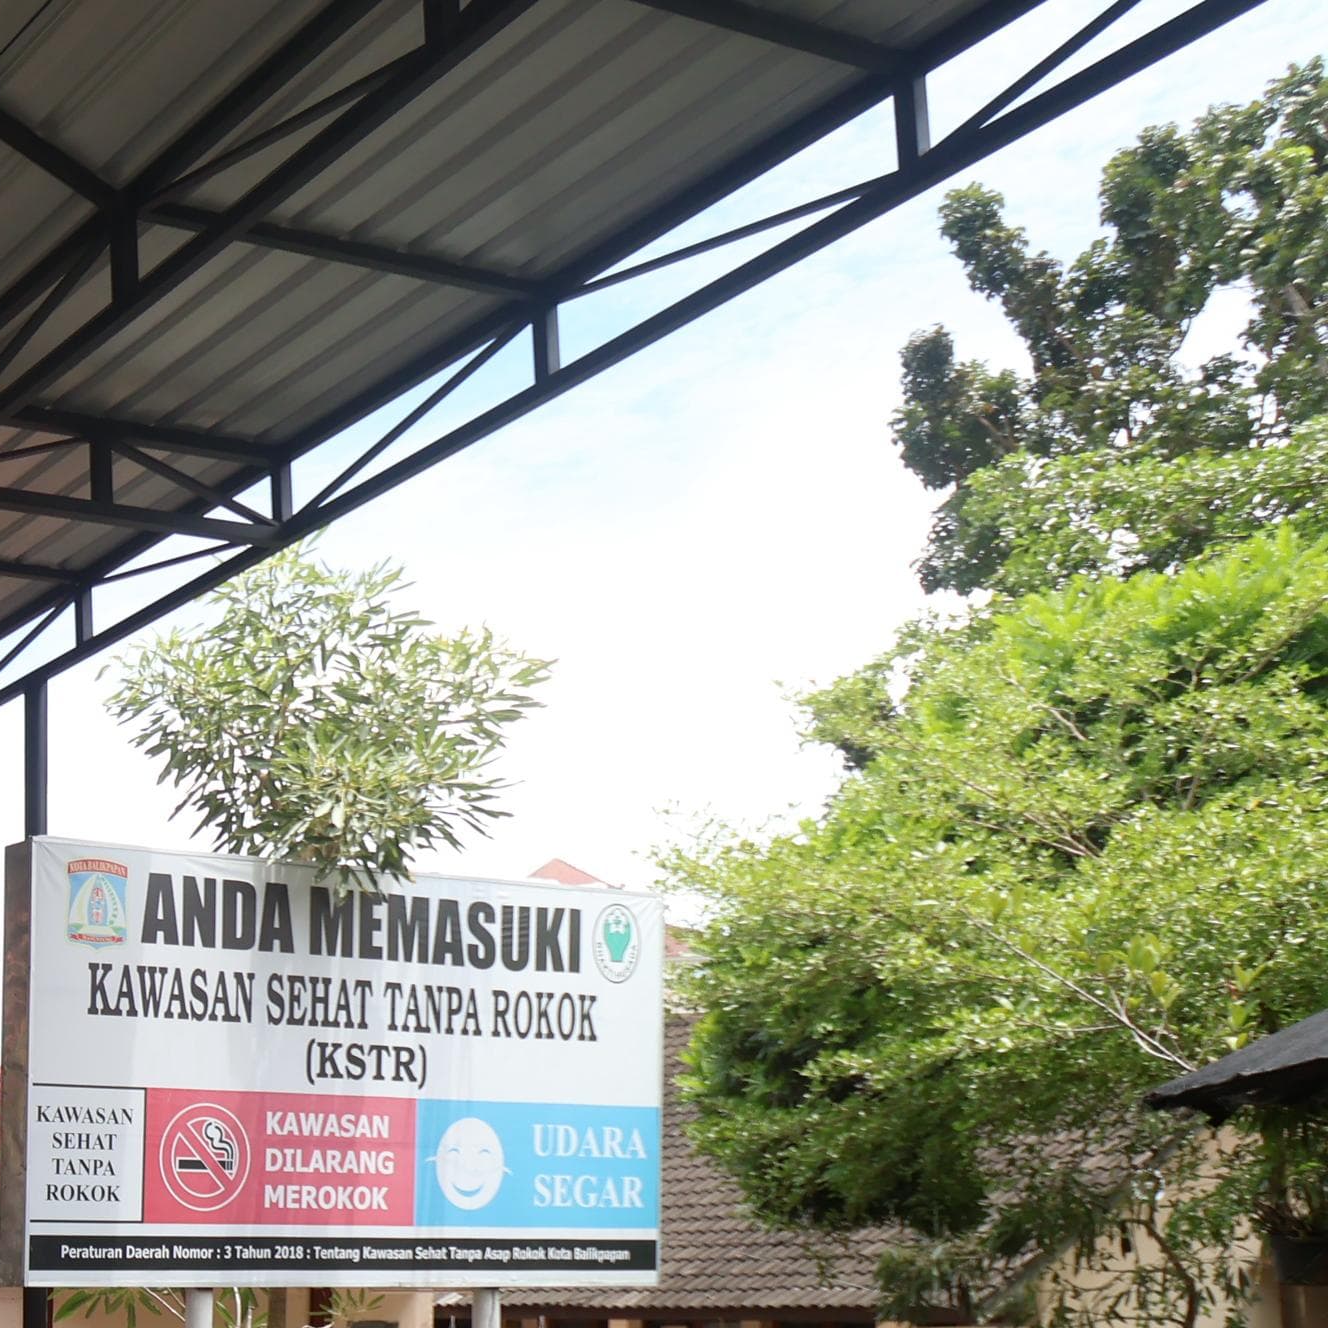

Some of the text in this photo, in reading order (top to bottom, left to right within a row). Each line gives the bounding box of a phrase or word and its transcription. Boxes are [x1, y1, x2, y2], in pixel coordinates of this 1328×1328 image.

[141, 873, 294, 953] ANDA
[309, 886, 581, 973] MEMASUKI
[88, 963, 597, 1042] KAWASAN SEHAT TANPA ROKOK
[306, 1038, 427, 1089] (KSTR)
[37, 1105, 133, 1125] KAWASAN
[266, 1111, 390, 1138] KAWASAN
[52, 1132, 117, 1150] SEHAT
[531, 1123, 646, 1159] UDARA
[52, 1158, 115, 1176] TANPA
[265, 1148, 395, 1175] DILARANG
[46, 1184, 120, 1202] ROKOK
[264, 1184, 388, 1211] MEROKOK
[533, 1174, 644, 1208] SEGAR
[61, 1245, 122, 1259] Peraturan
[126, 1245, 169, 1259] Daerah
[173, 1245, 214, 1259] Nomor
[224, 1246, 232, 1259] 3
[234, 1246, 271, 1259] Tahun
[274, 1246, 304, 1259] 2018
[313, 1246, 360, 1262] Tentang
[362, 1246, 413, 1260] Kawasan
[415, 1247, 447, 1260] Sehat
[448, 1247, 482, 1262] Tanpa
[484, 1247, 511, 1263] Asap
[512, 1247, 546, 1260] Rokok
[547, 1247, 572, 1260] Kota
[574, 1247, 631, 1263] Balikpapan
